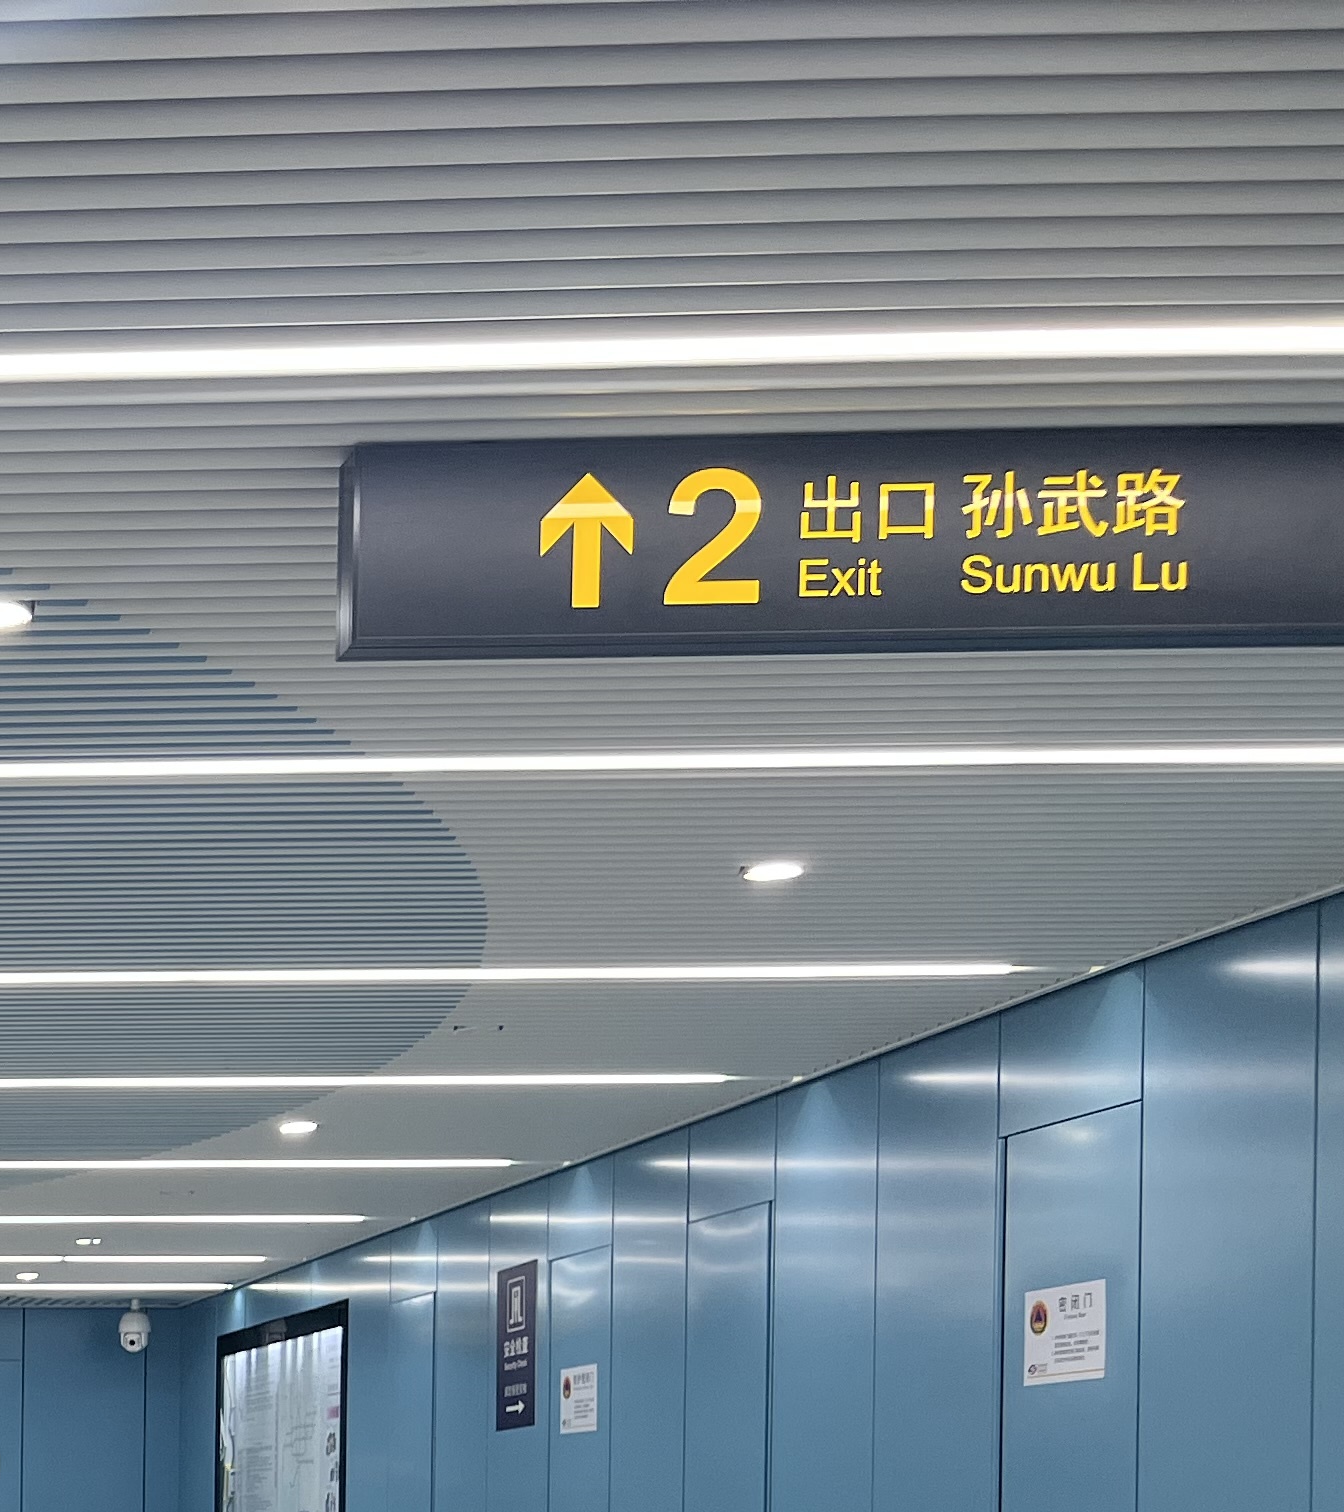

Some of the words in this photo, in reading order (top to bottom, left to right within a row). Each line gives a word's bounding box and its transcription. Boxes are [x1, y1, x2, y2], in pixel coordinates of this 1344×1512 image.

[664, 468, 762, 604] 2
[800, 475, 935, 542] 出口
[962, 469, 1185, 538] 孙武路
[800, 558, 883, 597] Exit
[962, 554, 1116, 594] Sunwu
[1132, 553, 1188, 591] Lu
